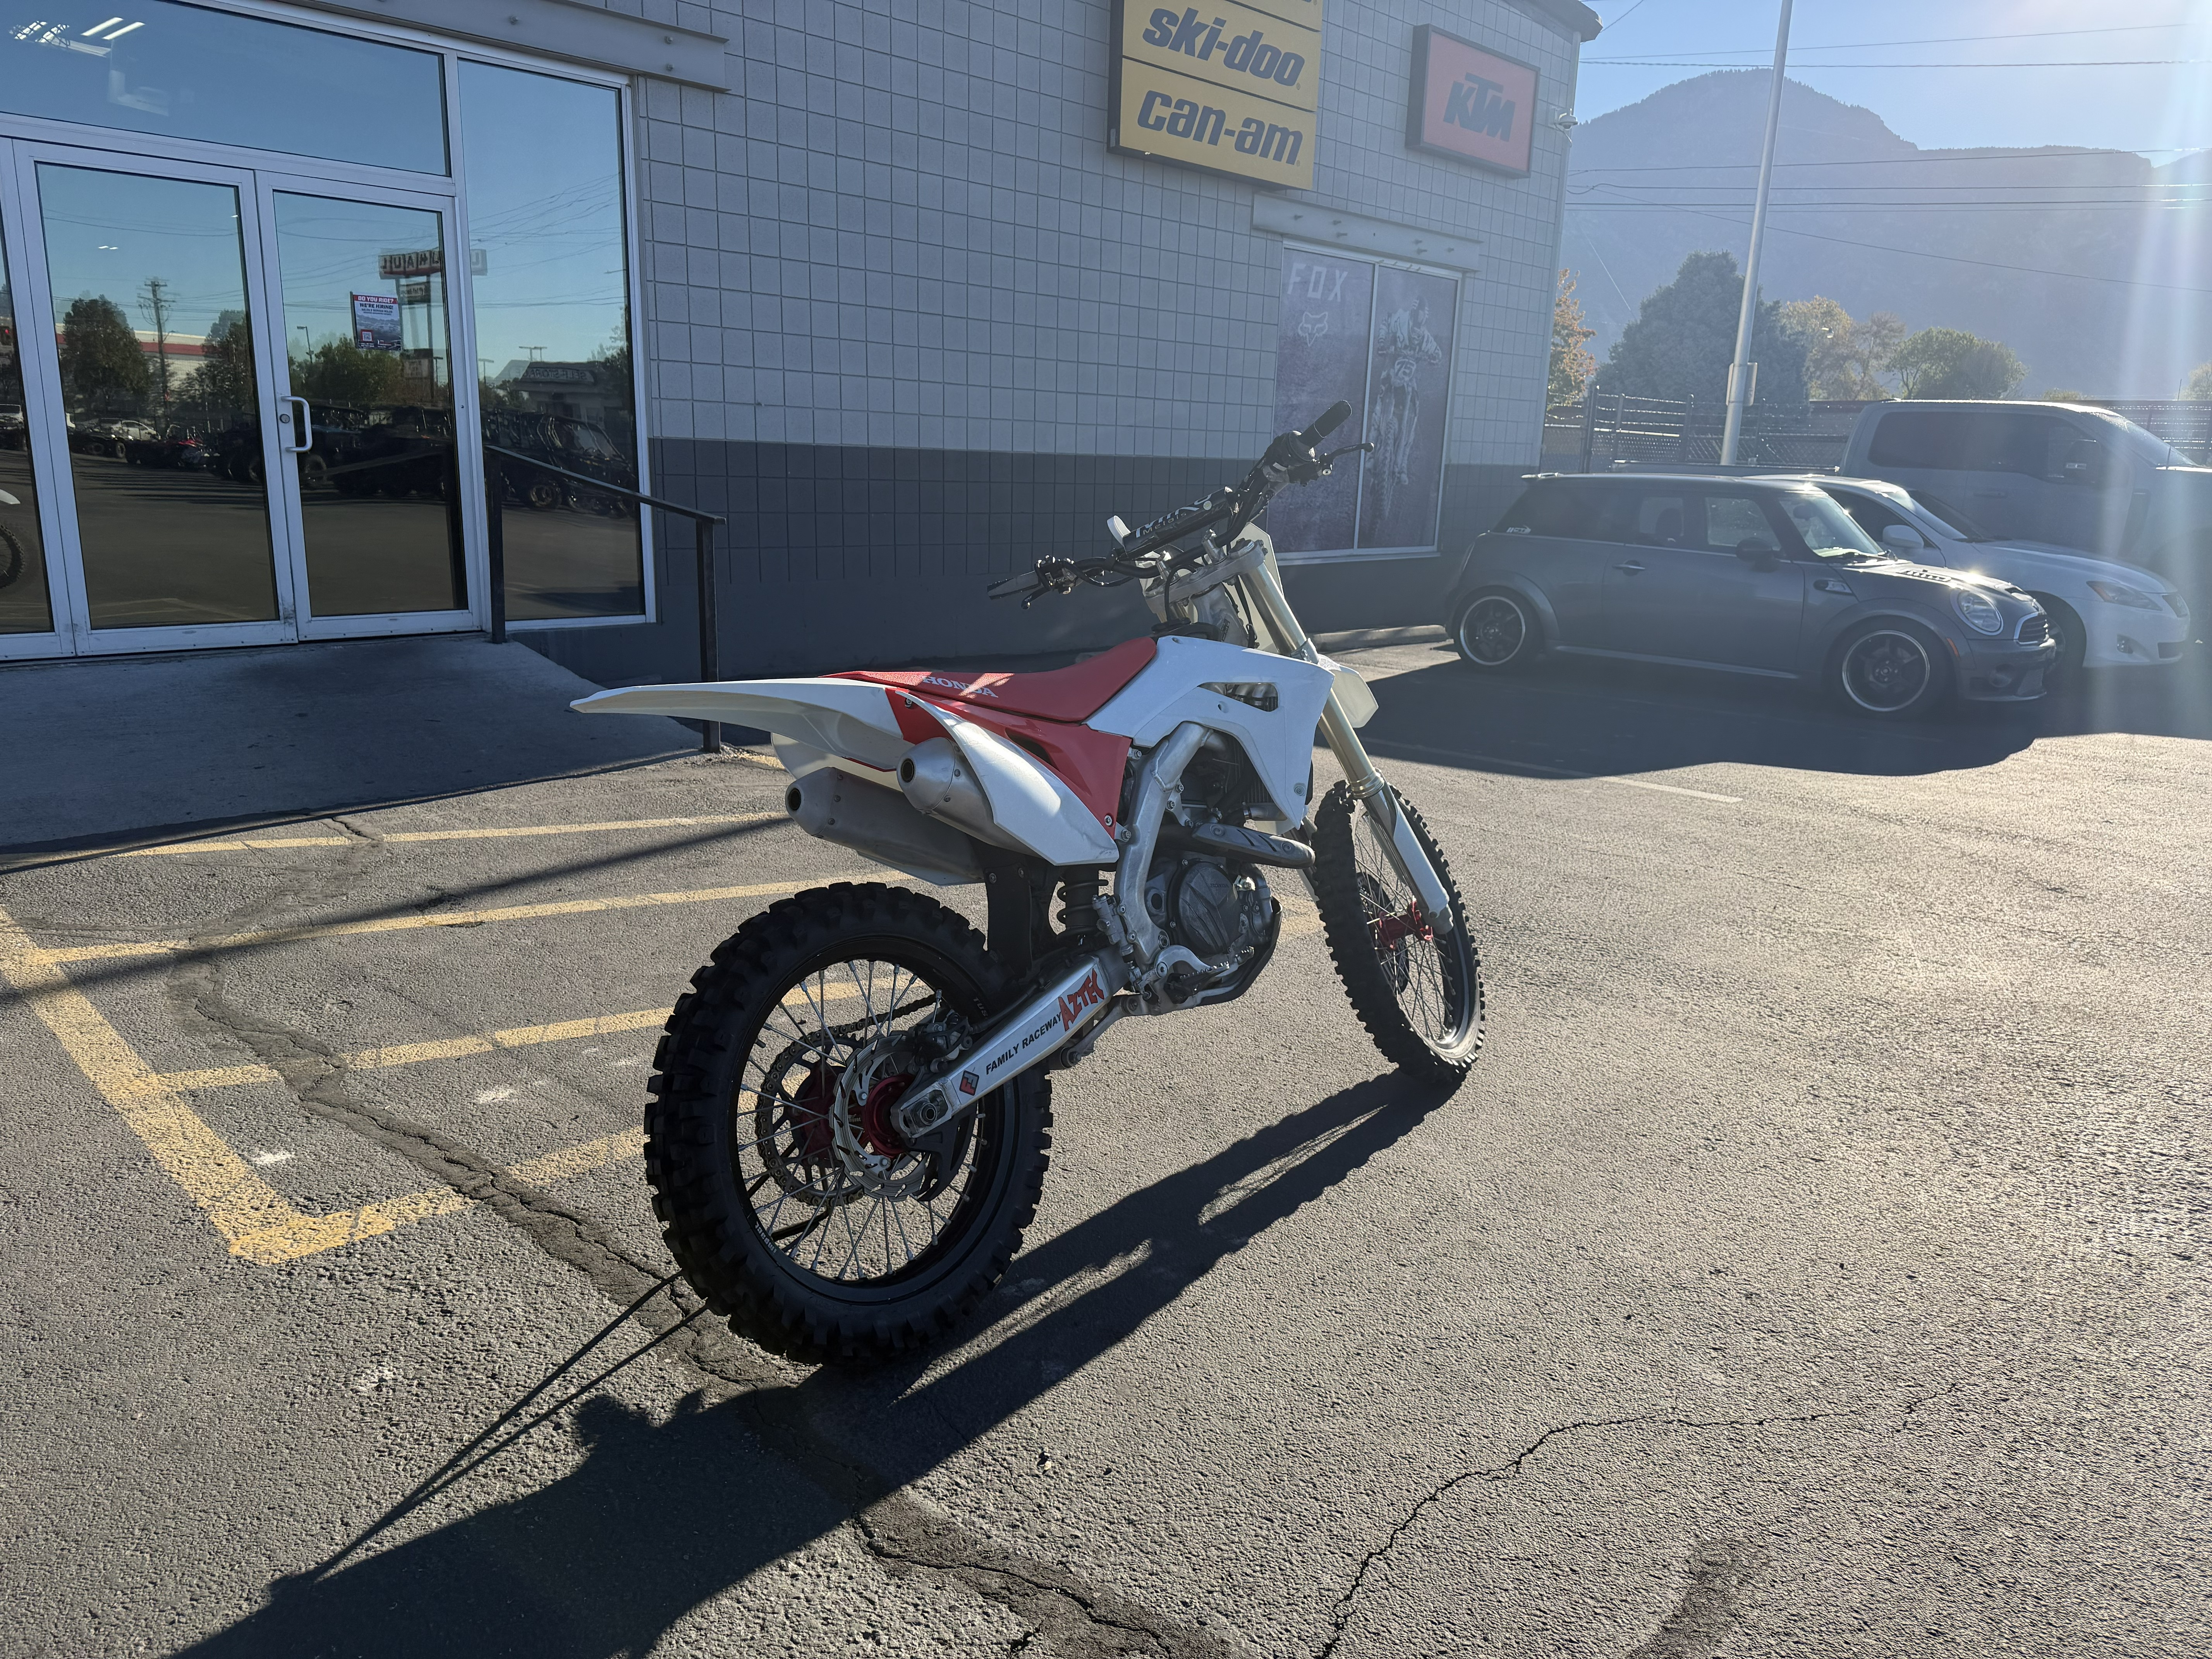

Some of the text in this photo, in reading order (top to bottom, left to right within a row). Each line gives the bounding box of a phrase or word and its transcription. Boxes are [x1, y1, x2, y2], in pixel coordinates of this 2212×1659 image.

[1142, 7, 1305, 86] ski-doo
[1137, 90, 1303, 165] can-am
[1443, 72, 1516, 142] KTM
[1287, 263, 1348, 302] FOX
[973, 996, 988, 1018] TUS
[986, 1012, 1061, 1075] FAMILY RACEWAY
